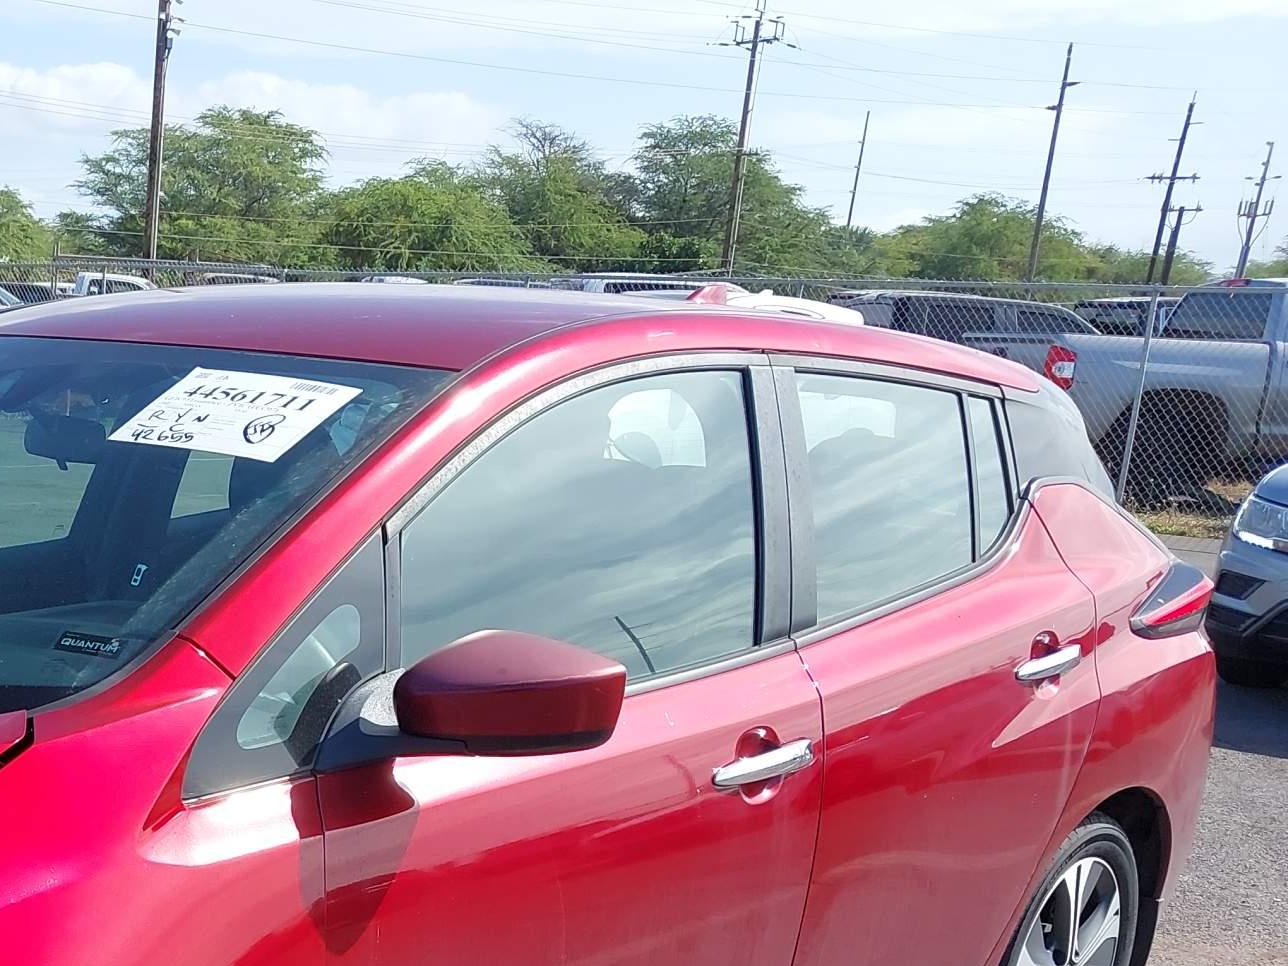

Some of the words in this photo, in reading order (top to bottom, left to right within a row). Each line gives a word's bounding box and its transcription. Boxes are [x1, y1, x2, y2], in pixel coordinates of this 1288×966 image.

[183, 385, 317, 411] 44561711
[131, 428, 194, 443] 42655
[60, 637, 119, 654] QUANTUM
